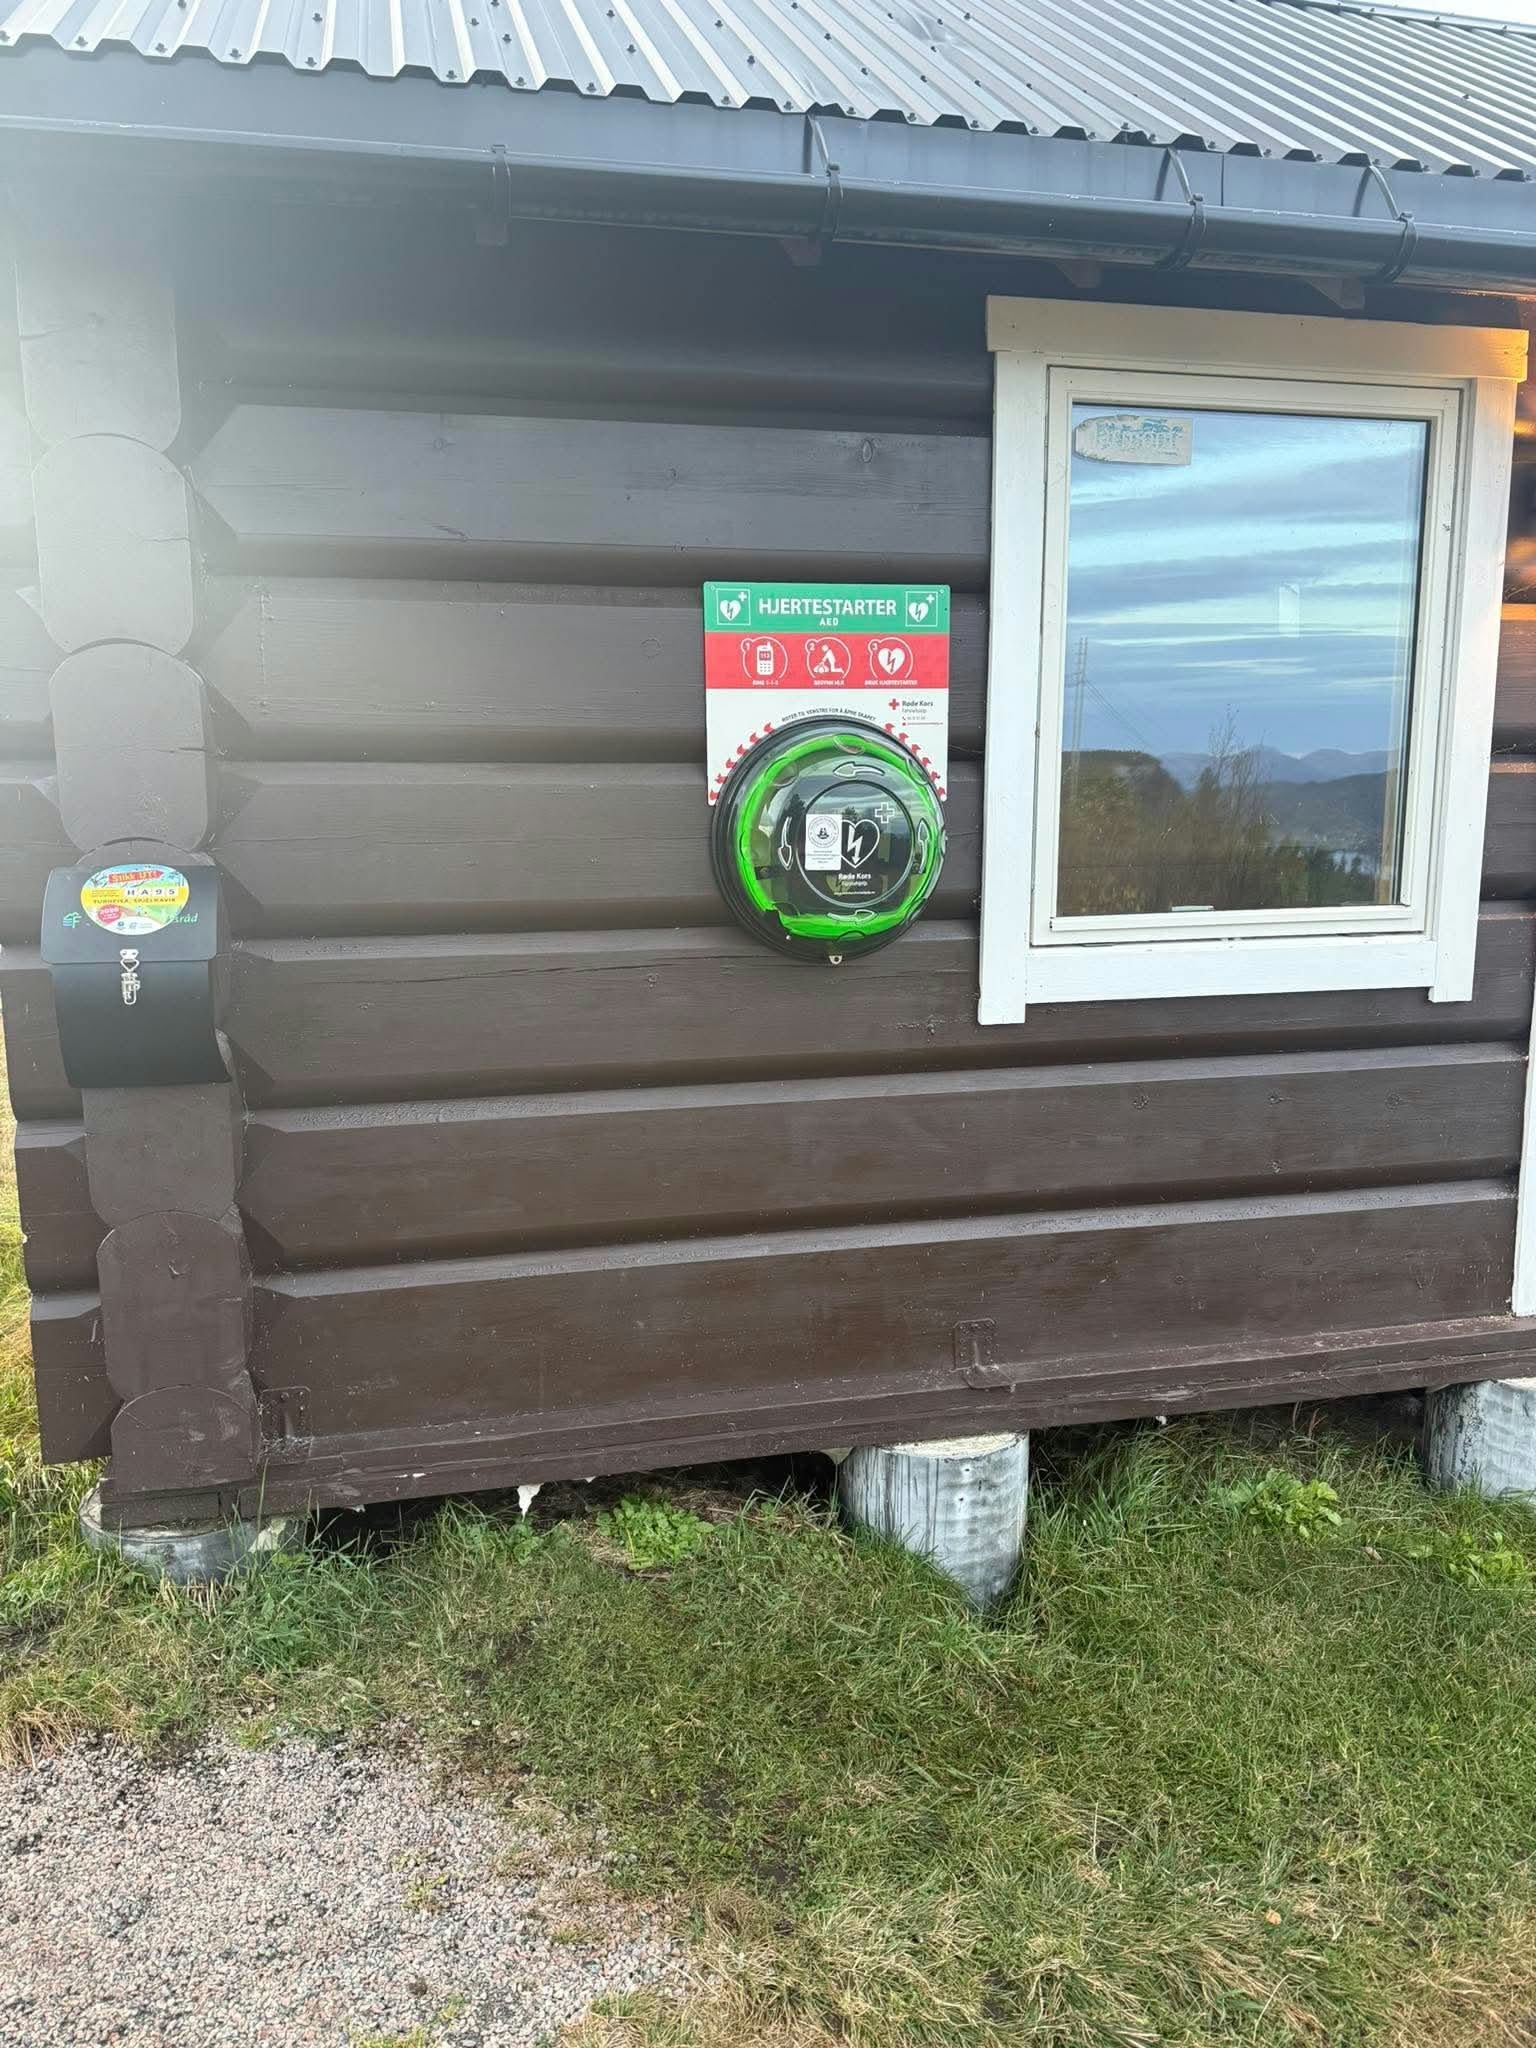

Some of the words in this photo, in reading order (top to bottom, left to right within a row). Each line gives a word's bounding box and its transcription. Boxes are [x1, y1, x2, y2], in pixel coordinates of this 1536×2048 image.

[758, 598, 897, 616] HJERTESTARTER
[819, 618, 839, 626] AED
[809, 643, 815, 651] 2
[806, 707, 828, 716] VENSTRE
[857, 872, 871, 880] Kors
